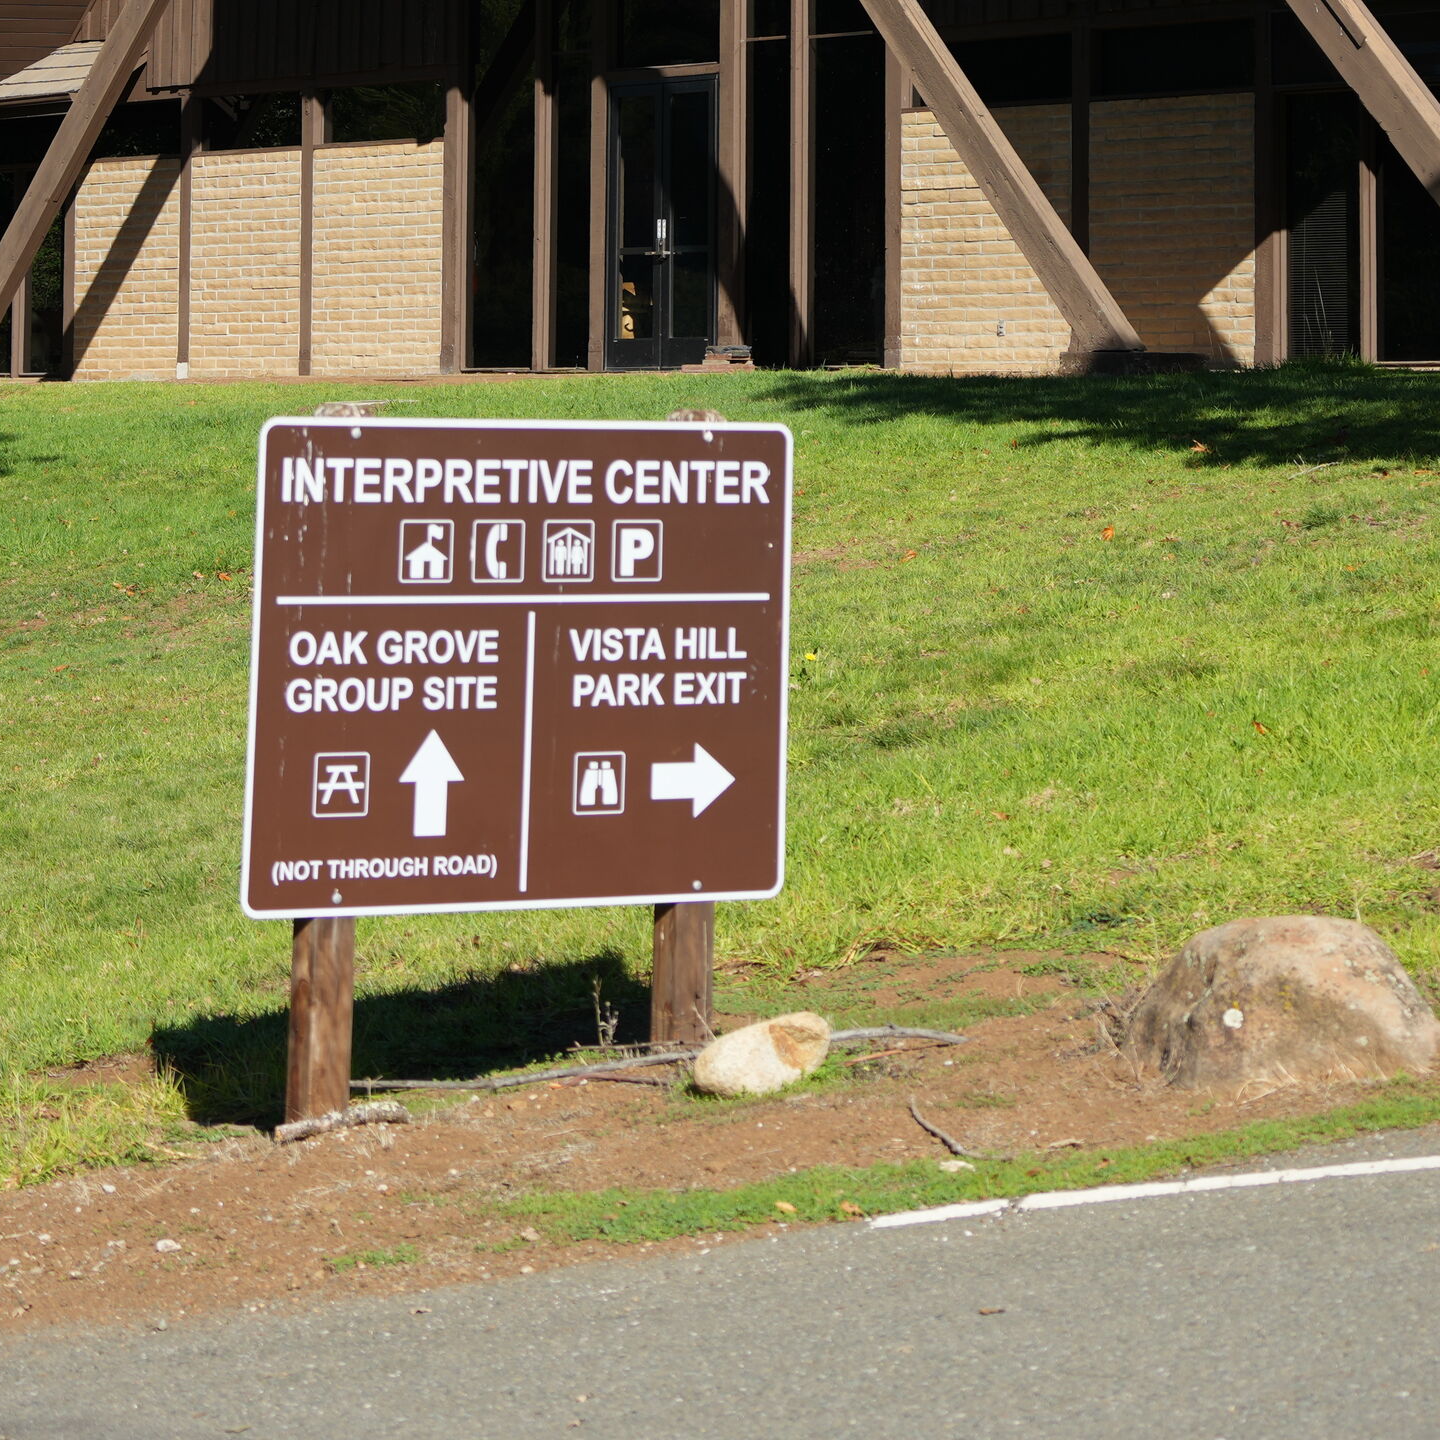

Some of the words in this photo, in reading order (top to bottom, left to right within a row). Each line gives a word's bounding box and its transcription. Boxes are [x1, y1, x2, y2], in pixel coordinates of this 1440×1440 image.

[281, 456, 594, 504] INTERPRETIVE
[604, 459, 771, 505] CENTER
[619, 527, 655, 577] P
[289, 630, 369, 666] OAK
[376, 629, 500, 665] GROVE
[569, 627, 667, 662] VISTA
[674, 626, 748, 660] HILL
[284, 676, 414, 714] GROUP
[422, 675, 498, 711] SITE
[572, 672, 665, 708] PARK
[673, 671, 748, 706] EXIT
[271, 859, 324, 886] (NOT
[326, 856, 429, 880] THROUGH
[432, 853, 498, 879] ROAD)
